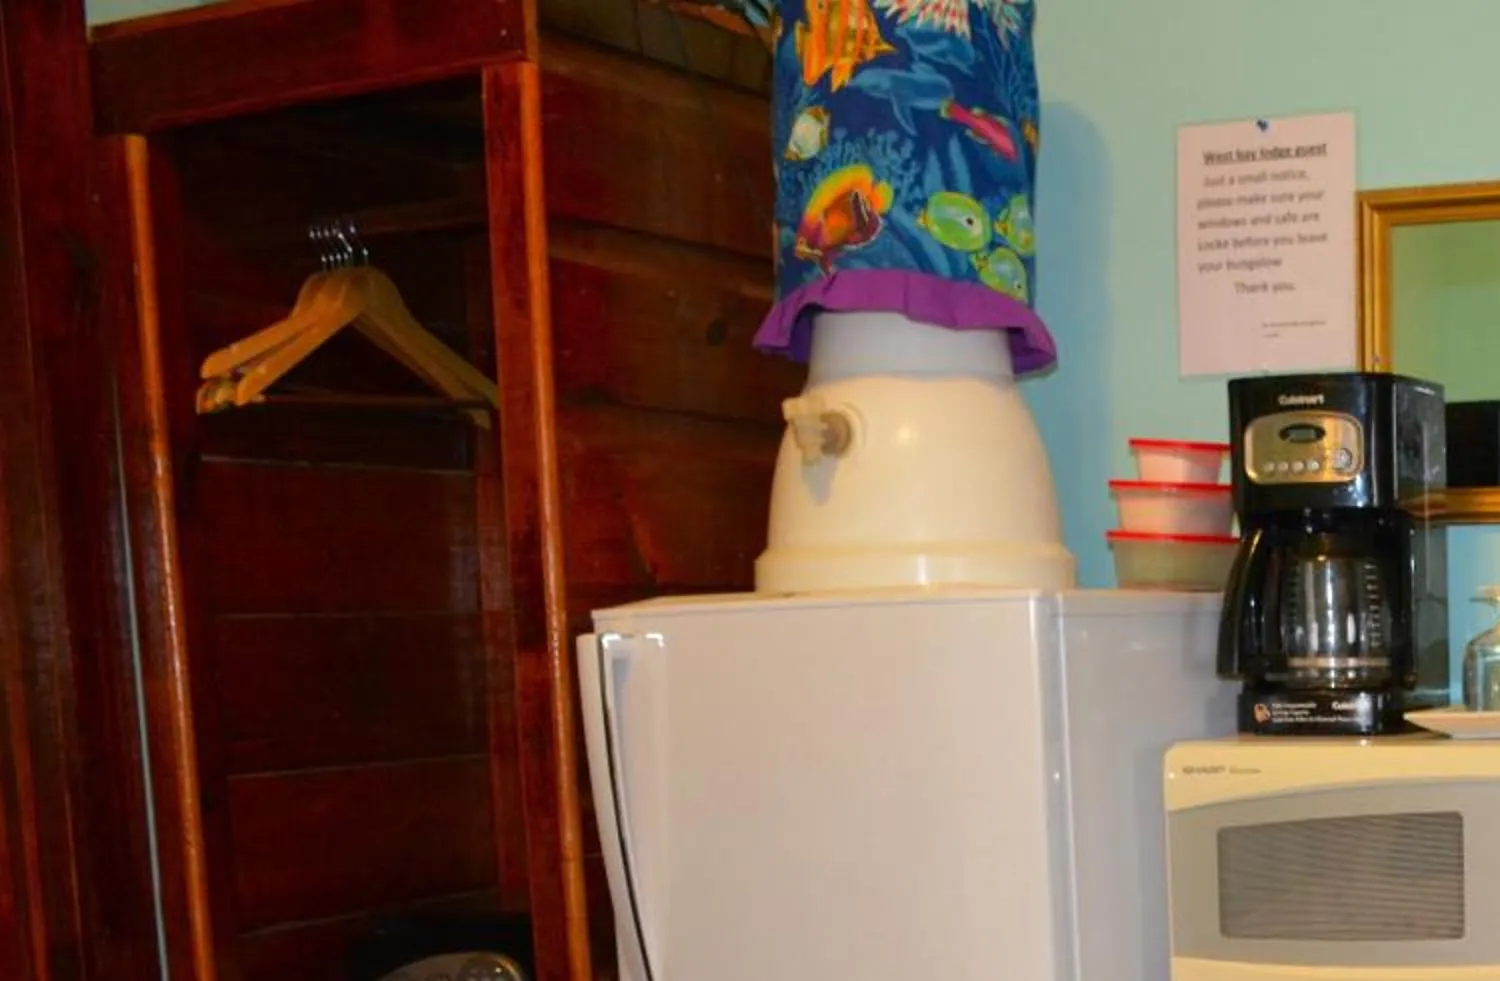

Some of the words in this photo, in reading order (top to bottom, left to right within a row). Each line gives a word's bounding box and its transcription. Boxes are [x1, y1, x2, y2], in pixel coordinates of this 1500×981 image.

[1202, 150, 1232, 166] West
[1236, 148, 1256, 162] bay
[1260, 145, 1291, 161] lodge
[1295, 143, 1327, 159] guest
[1228, 176, 1236, 186] a
[1238, 170, 1267, 185] small
[1196, 195, 1233, 211] please
[1236, 193, 1266, 205] make
[1270, 192, 1295, 204] sure
[1297, 190, 1324, 204] your
[1197, 216, 1247, 230] windows
[1250, 213, 1272, 226] and
[1274, 210, 1298, 225] safe
[1301, 211, 1320, 223] are
[1232, 235, 1270, 248] before
[1273, 235, 1294, 248] you
[1296, 231, 1328, 244] leave
[1197, 261, 1223, 274] your
[1226, 257, 1283, 272] bungalow
[1234, 280, 1268, 294] Thank
